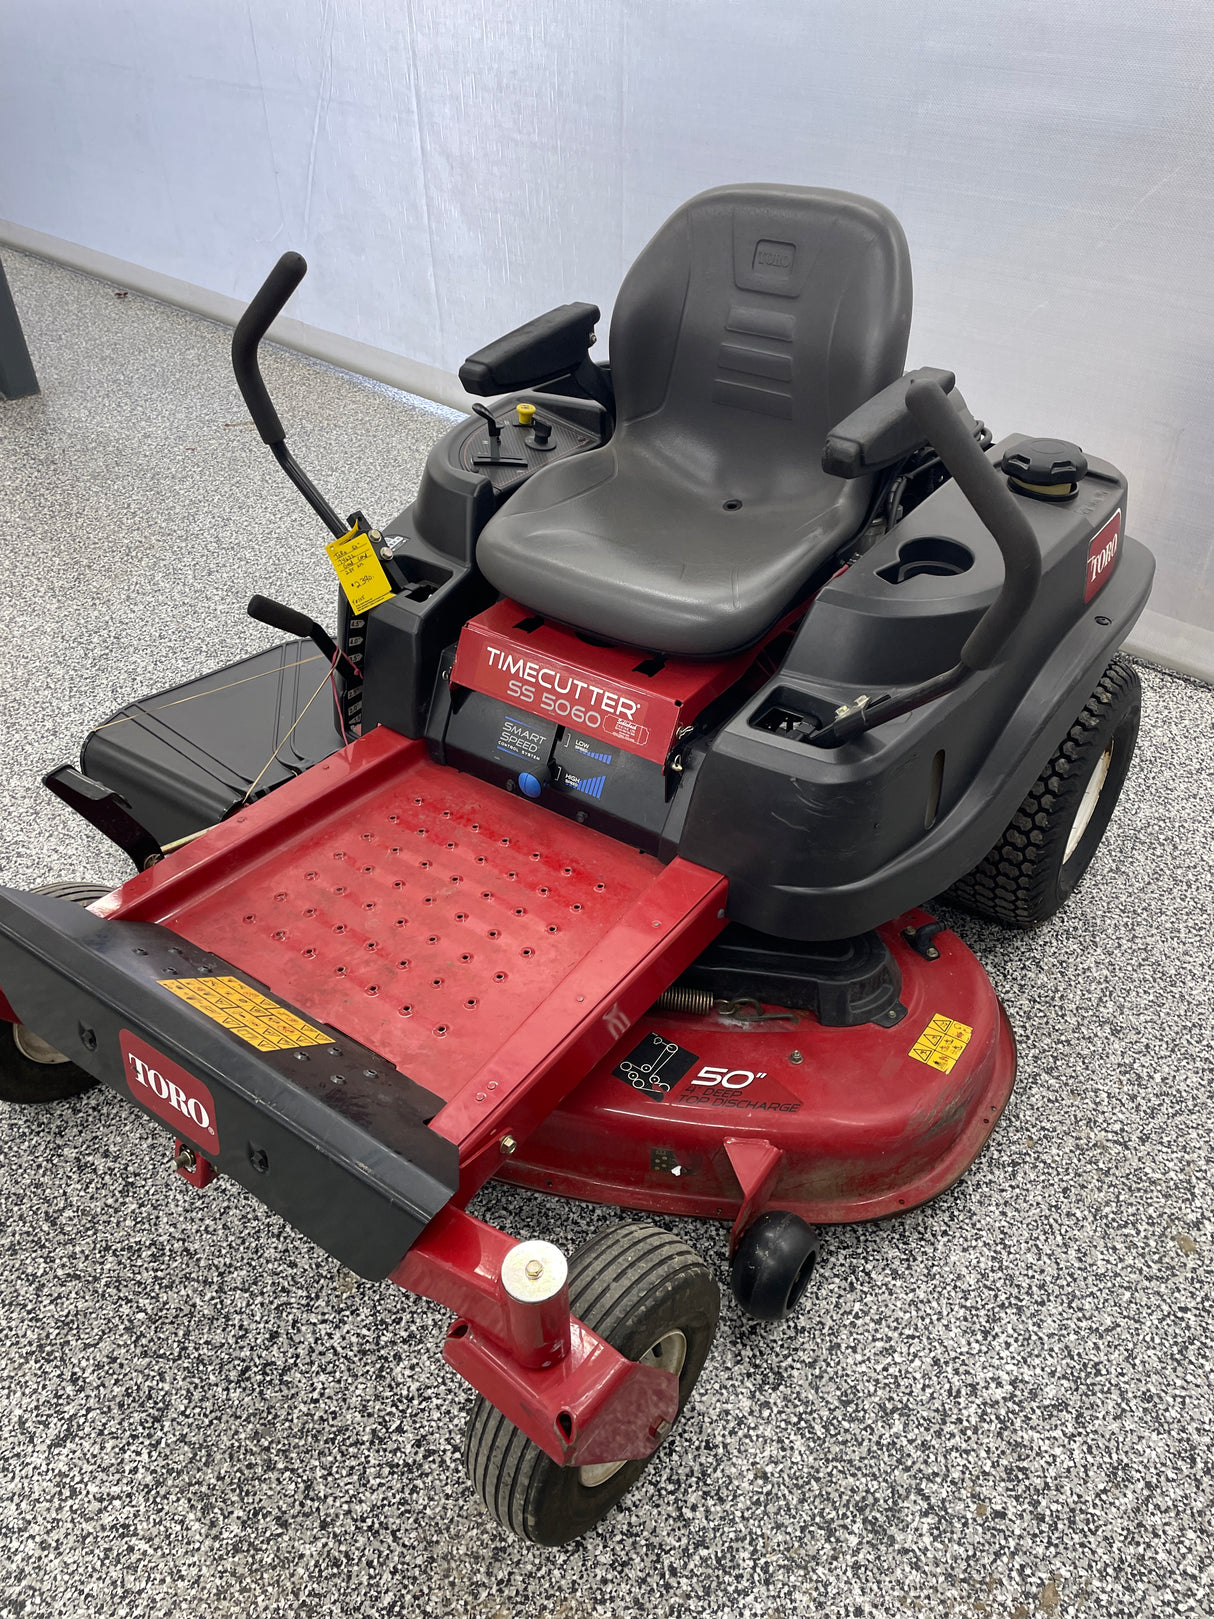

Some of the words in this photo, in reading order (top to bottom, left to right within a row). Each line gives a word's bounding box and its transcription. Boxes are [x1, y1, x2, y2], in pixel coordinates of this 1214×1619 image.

[1087, 533, 1118, 582] TORO
[487, 647, 635, 720] TIMECUTTER
[507, 680, 535, 702] SS
[540, 692, 601, 728] 5060
[500, 731, 538, 753] SPEED
[502, 721, 547, 744] SMART
[497, 740, 519, 752] CONTROL
[521, 750, 541, 761] SYSTEM
[575, 739, 590, 749] LOW
[565, 773, 581, 783] HIGH
[690, 1066, 768, 1089] 50"
[128, 1052, 210, 1128] TORO
[702, 1086, 744, 1098] DEEP
[679, 1094, 709, 1105] TOP
[708, 1098, 802, 1113] DISCHARGE
